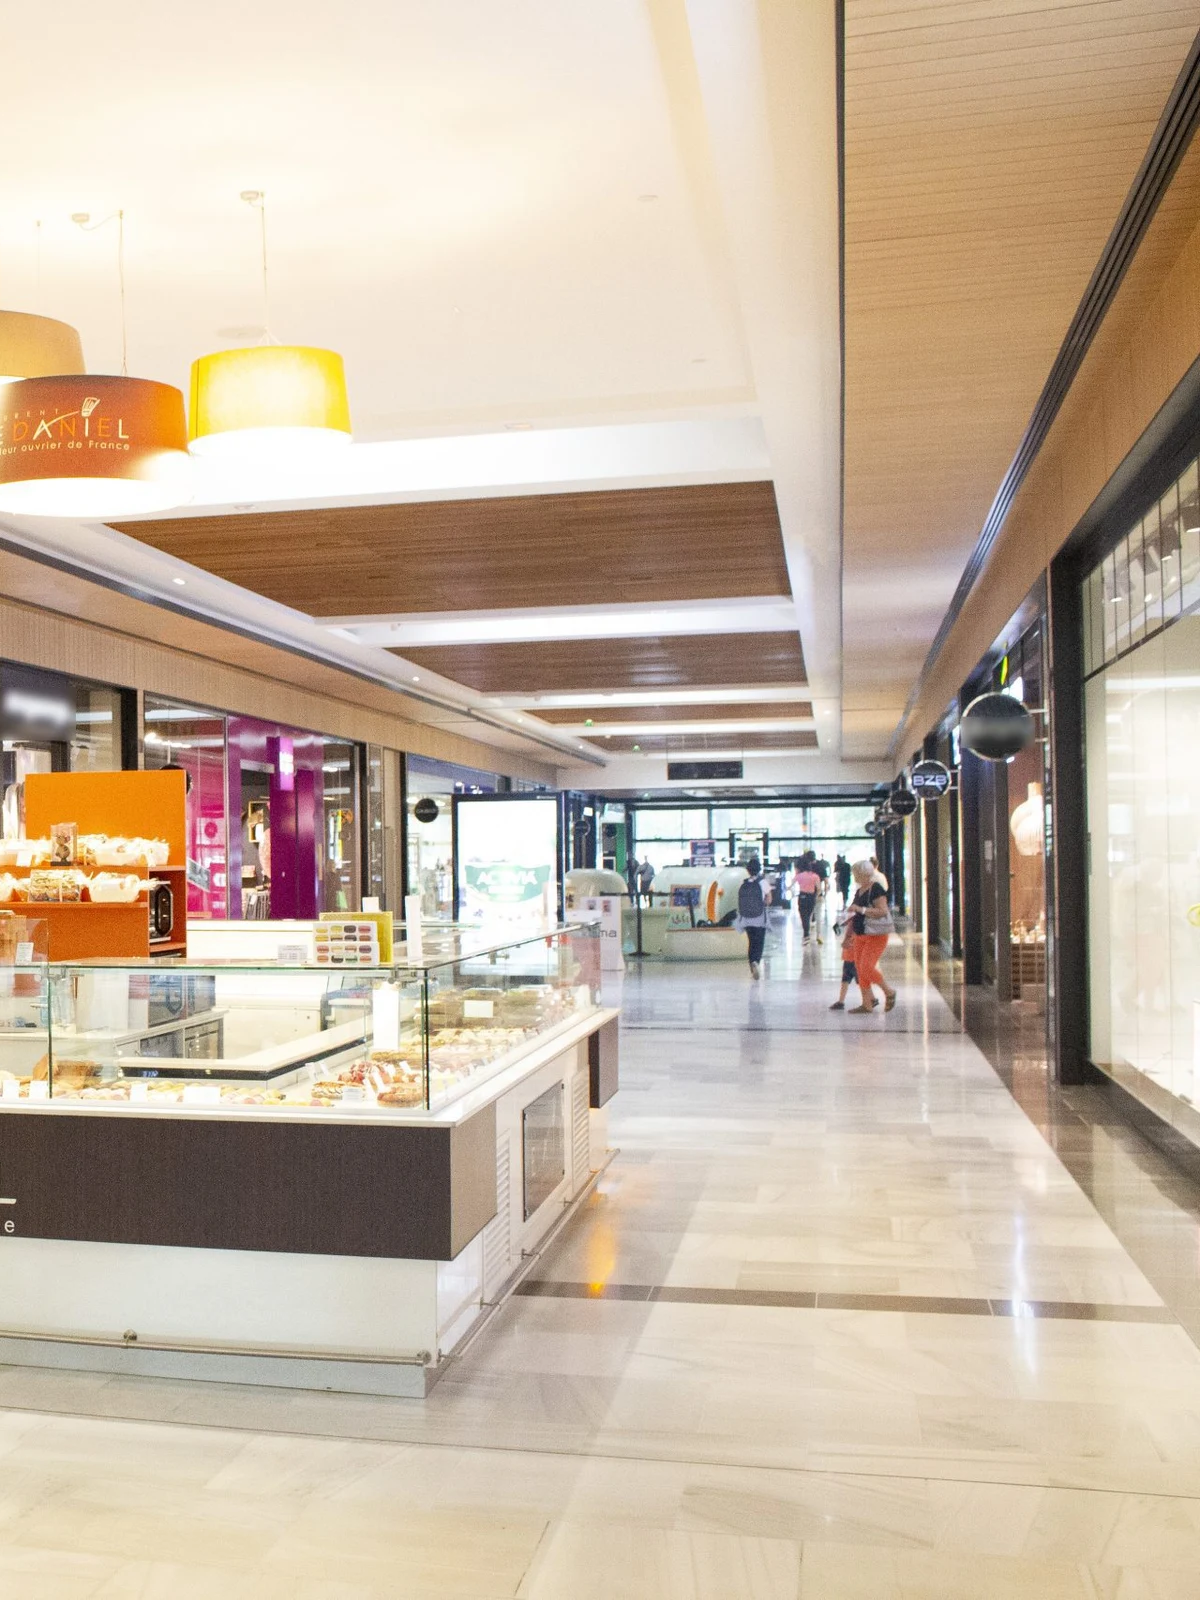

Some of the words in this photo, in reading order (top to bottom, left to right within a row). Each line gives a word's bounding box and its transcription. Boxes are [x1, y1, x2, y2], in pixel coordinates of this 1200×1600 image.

[13, 417, 130, 442] DANIEL
[21, 439, 62, 451] ouvrier
[67, 440, 83, 450] de
[88, 440, 131, 451] France
[476, 870, 538, 885] ACVIA
